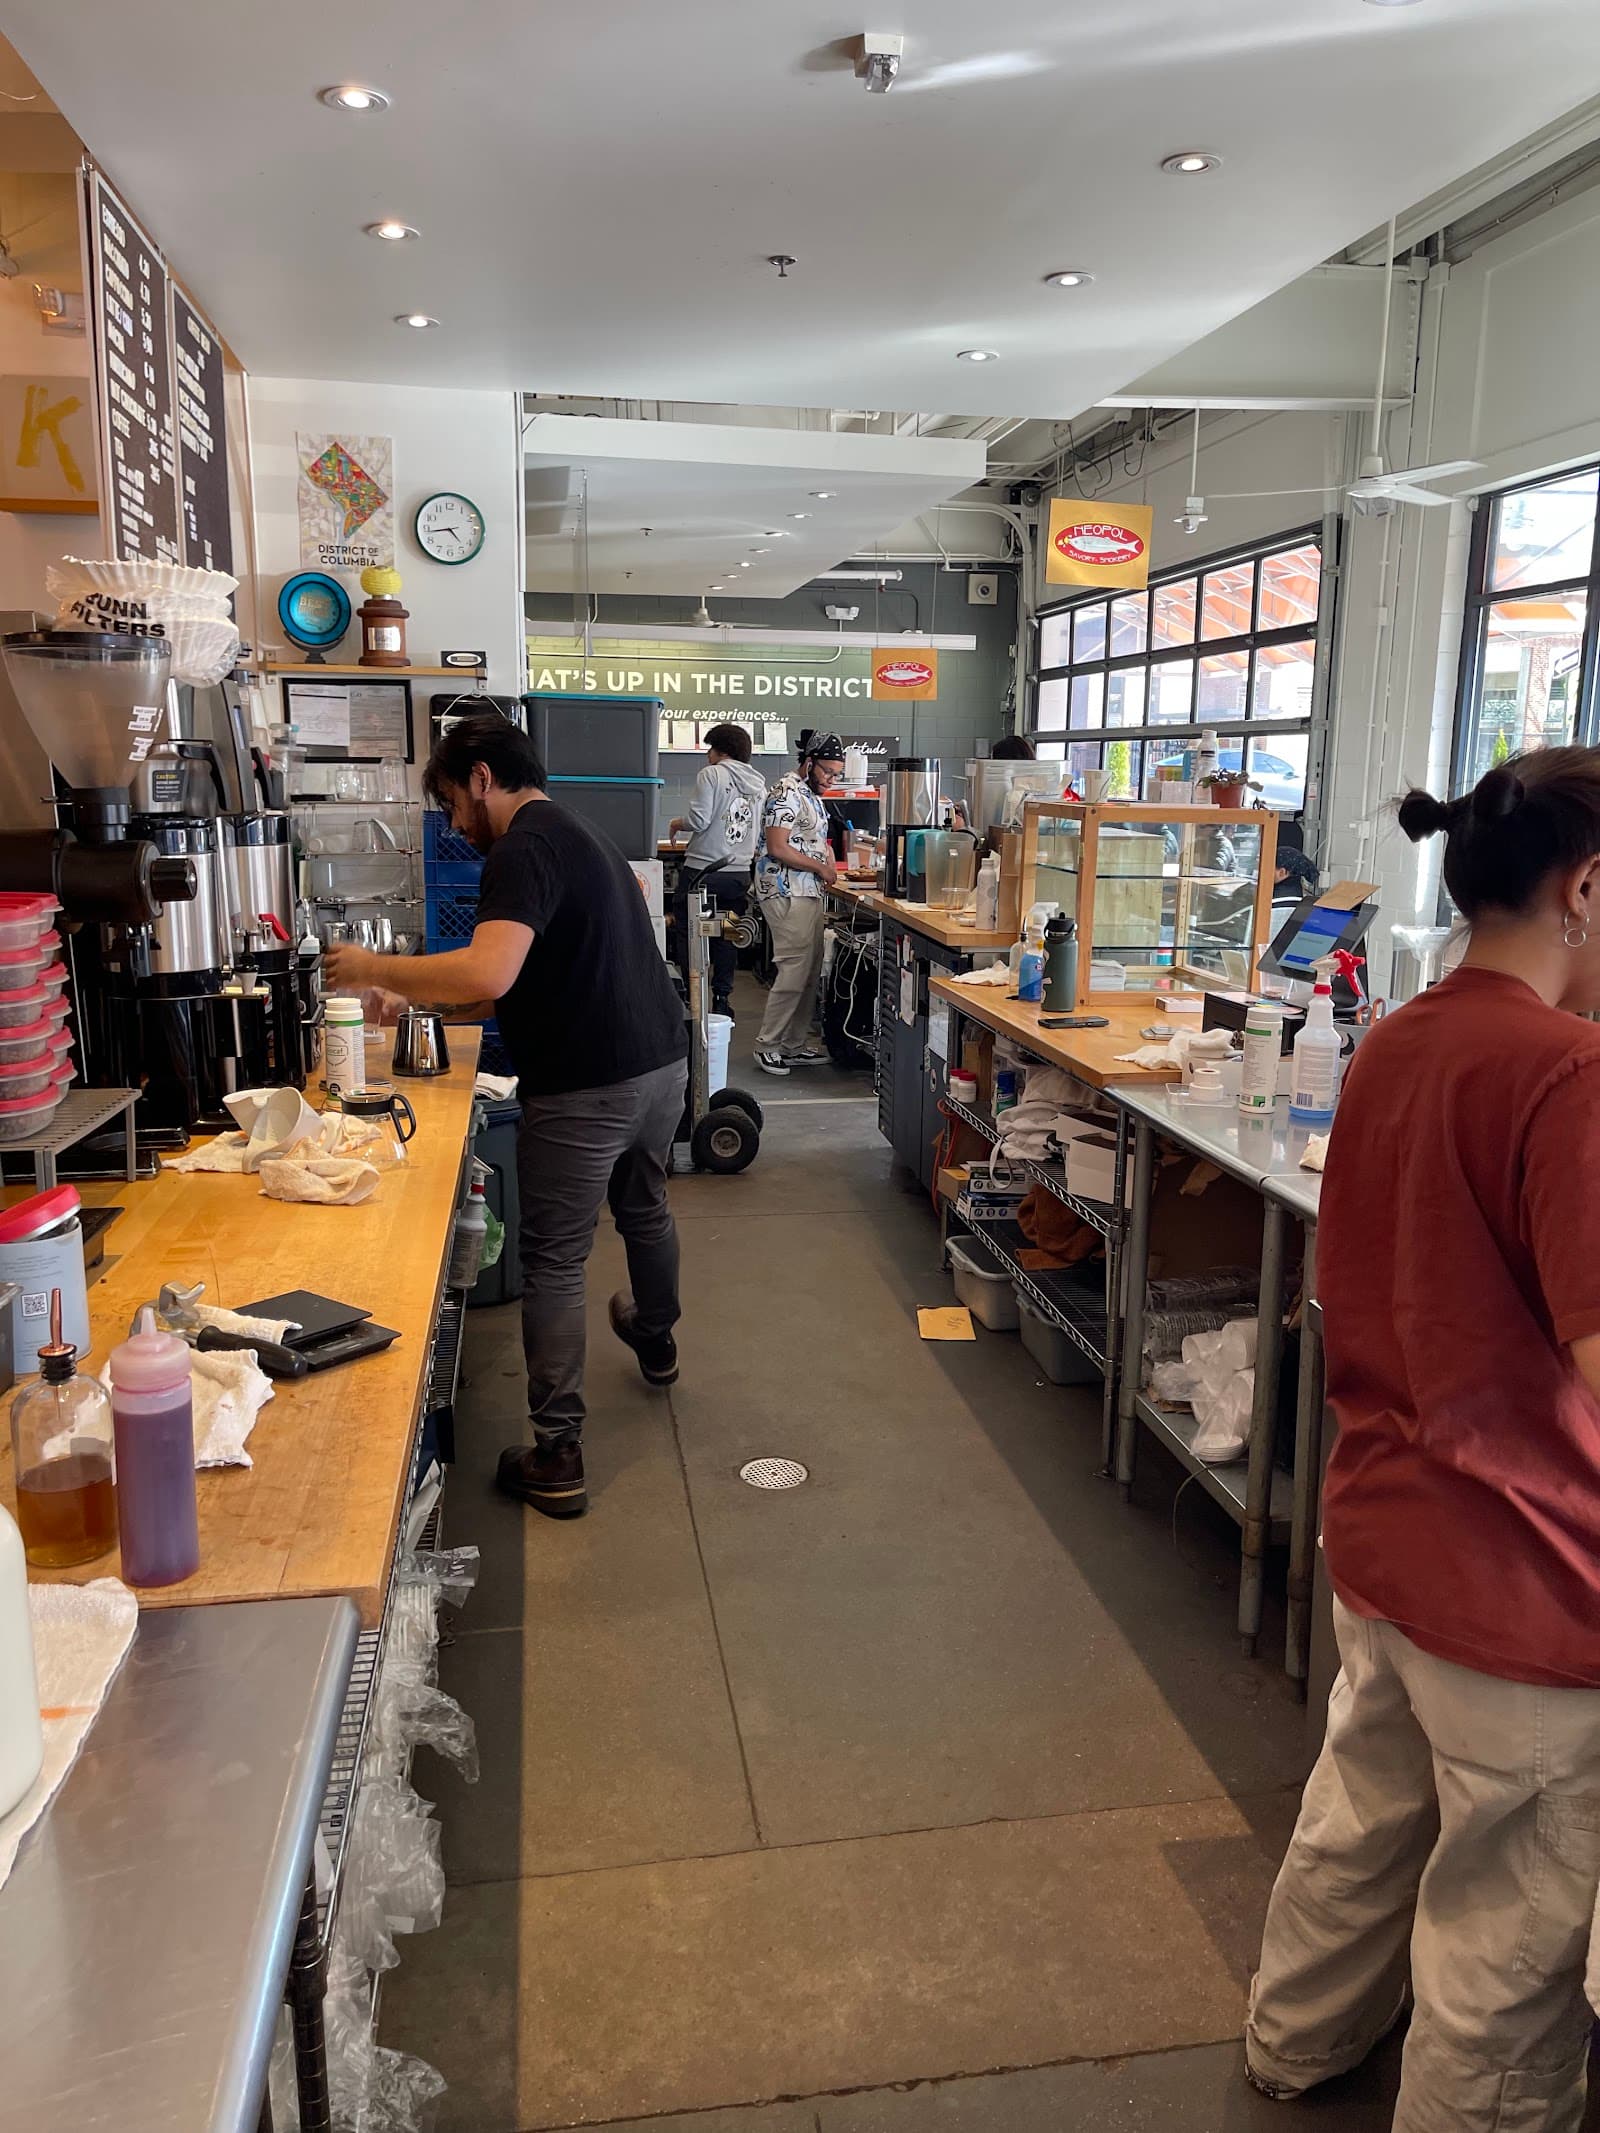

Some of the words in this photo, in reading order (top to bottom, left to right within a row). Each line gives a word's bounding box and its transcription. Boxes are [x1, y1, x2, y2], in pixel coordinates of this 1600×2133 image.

[16, 384, 85, 493] K
[1073, 524, 1128, 541] NEOPOL
[318, 544, 366, 556] DISTRICT
[367, 547, 379, 555] OF
[320, 555, 377, 567] COLUMBIA
[70, 601, 165, 637] FILTERS
[528, 669, 597, 691] AT'S
[607, 671, 644, 692] UP
[654, 672, 681, 693] IN
[691, 673, 745, 695] THE
[755, 675, 872, 698] DISTRICT
